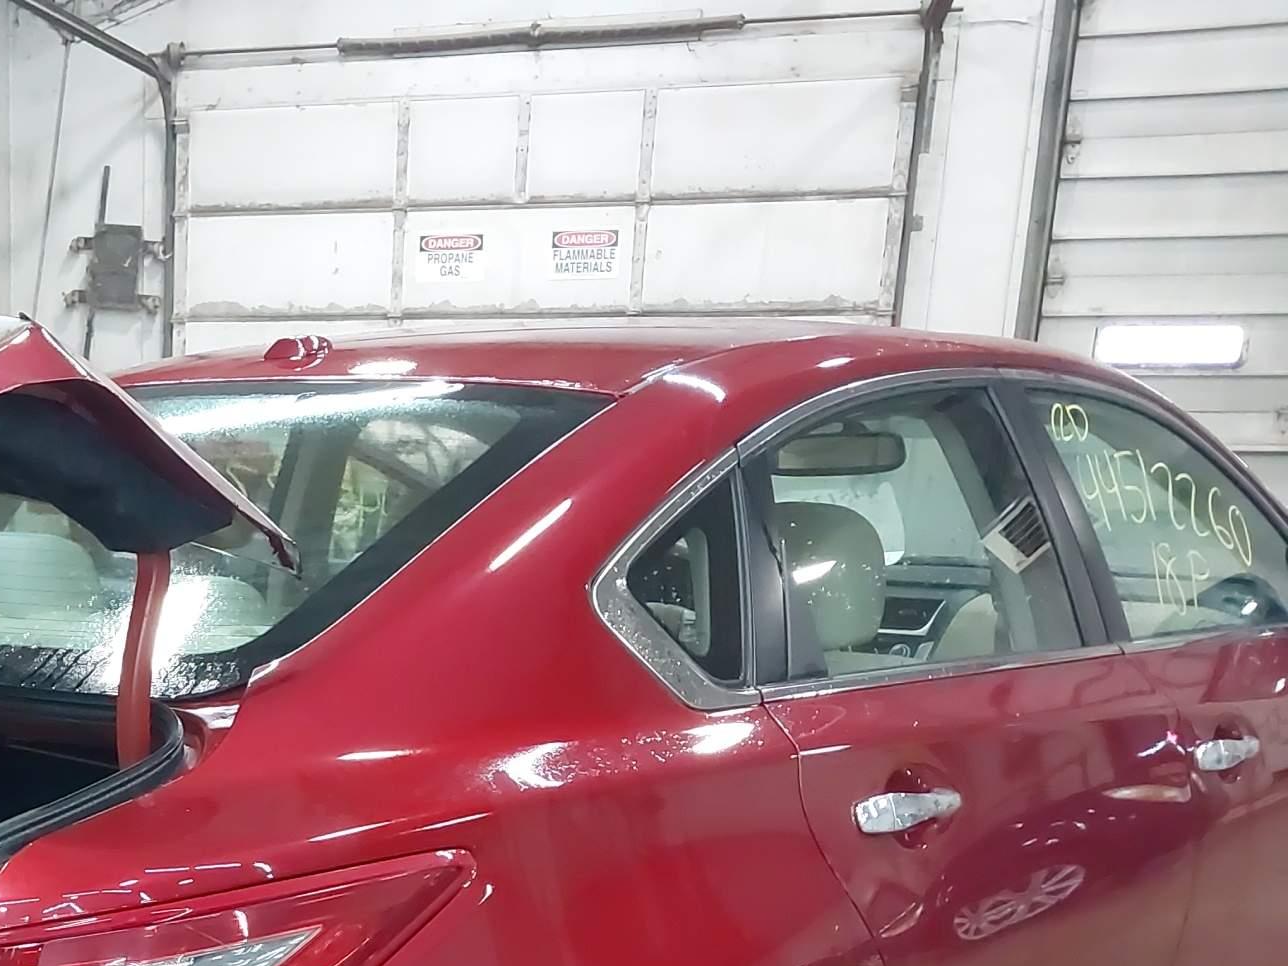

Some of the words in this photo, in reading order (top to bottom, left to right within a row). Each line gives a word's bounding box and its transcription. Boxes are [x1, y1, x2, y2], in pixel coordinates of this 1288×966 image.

[427, 237, 475, 249] DANGER
[561, 233, 610, 245] DANGER
[427, 252, 474, 264] PROPANE
[553, 248, 617, 261] FLAMMABLE
[440, 265, 461, 277] GAS
[554, 261, 613, 273] MATERIALS
[1076, 448, 1253, 567] 44512260
